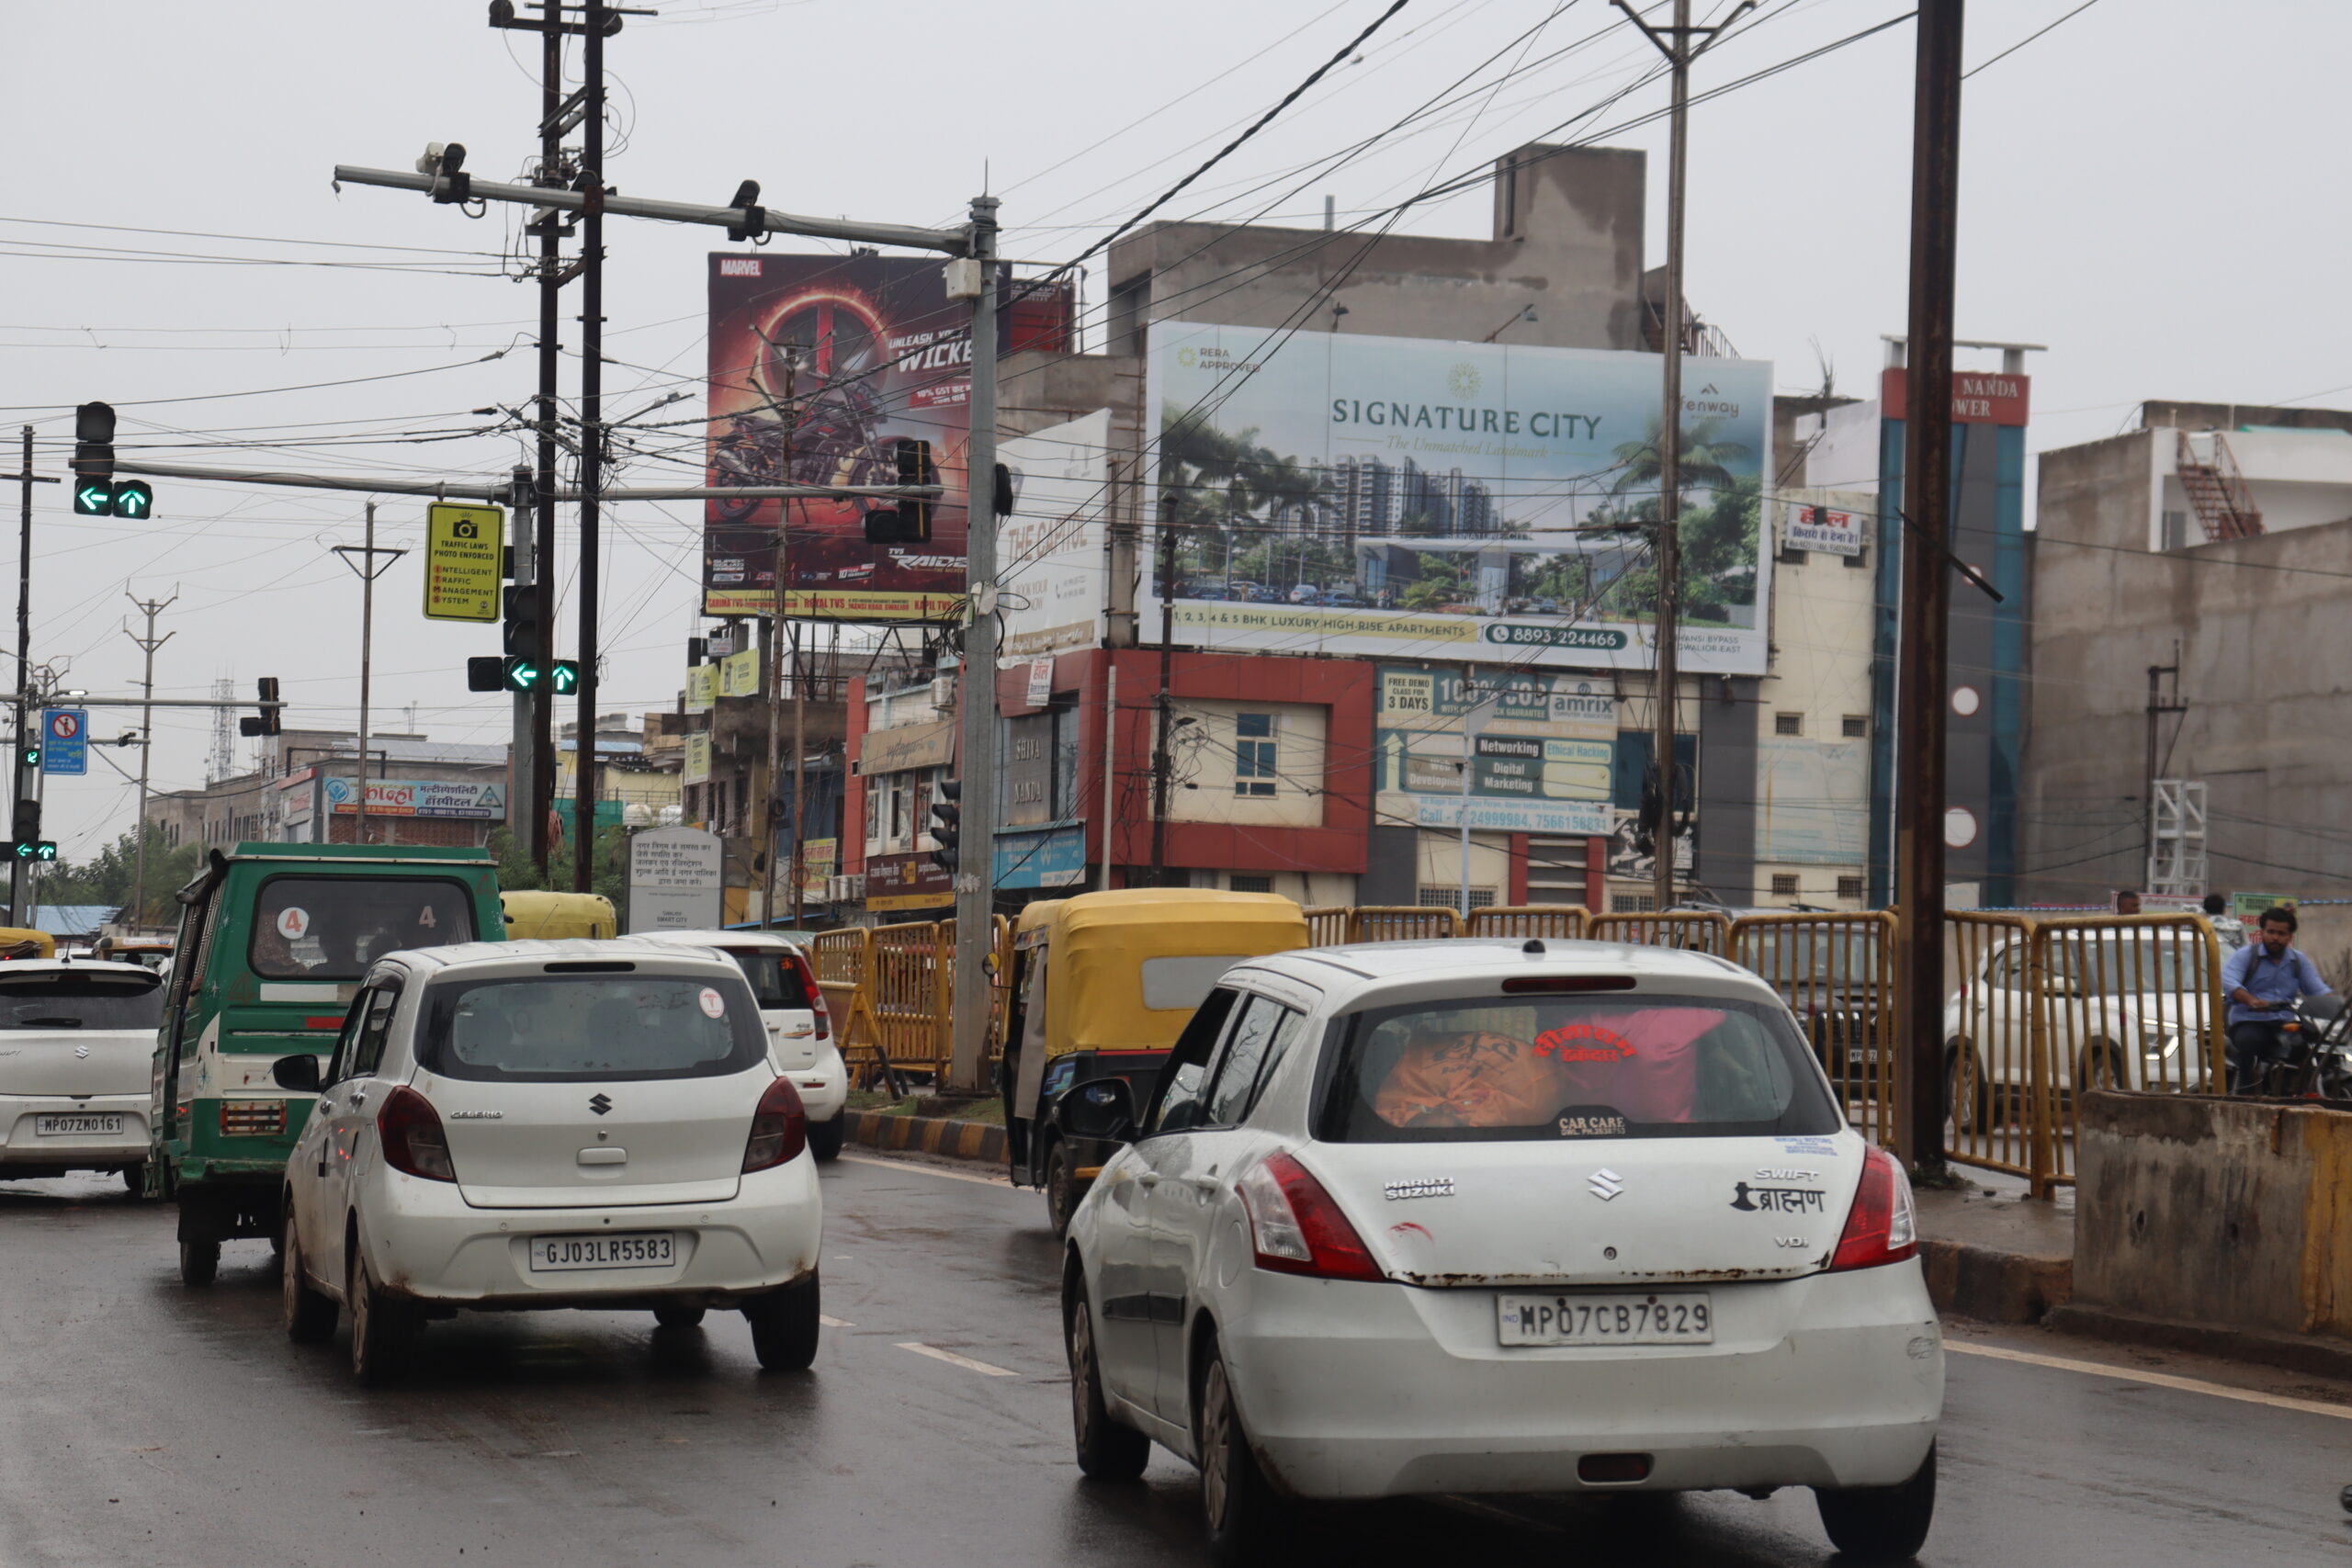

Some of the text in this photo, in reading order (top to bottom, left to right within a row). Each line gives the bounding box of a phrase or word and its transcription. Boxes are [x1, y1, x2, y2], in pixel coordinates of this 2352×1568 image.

[721, 259, 761, 276] MARVEL
[889, 333, 933, 349] UNLEASH
[899, 340, 972, 373] WICKE
[1200, 347, 1230, 358] RERA
[1199, 360, 1261, 373] APPROVED
[935, 387, 950, 395] GST
[1963, 378, 2018, 398] NANDA
[1679, 395, 1739, 419] fenway
[1333, 398, 1602, 441] SIGNATURE CITY
[1386, 434, 1549, 458] The Unmatched Landmark
[441, 540, 489, 550] TRAFFIC LAWS
[1009, 511, 1088, 565] THE CAPITOL
[459, 552, 494, 560] ENFORCED
[888, 555, 967, 570] RAIDE
[434, 565, 492, 576] INTELLIGENT
[433, 575, 471, 585] TRAFFIC
[433, 585, 493, 596] MANAGEMENT
[433, 595, 469, 604] SYSTEM
[804, 598, 828, 608] ROYAL
[830, 598, 845, 608] TVS
[1185, 612, 1193, 623] 2,
[1198, 613, 1205, 623] 3,
[1209, 614, 1216, 622] 4
[1221, 614, 1228, 623] &
[1233, 615, 1238, 623] 5
[1243, 615, 1267, 626] BHK
[1272, 616, 1319, 628] LUXURY
[1324, 619, 1383, 632] HIGH-RISE
[1387, 625, 1464, 637] APARTMENTS
[1514, 625, 1616, 647] 8893-224466
[1678, 634, 1738, 644] HANSI BYPASS
[1388, 678, 1430, 688] FREE DEMO
[1392, 687, 1411, 695] CLASS
[1506, 682, 1547, 706] JOB
[1388, 696, 1429, 710] 3 DAYS
[1554, 696, 1613, 713] amrix
[1016, 739, 1041, 761] SHIVA
[1480, 739, 1539, 758] Networking
[1547, 743, 1610, 761] Ethical Hacking
[1493, 762, 1525, 775] Digital
[1485, 777, 1533, 794] Marketing
[1014, 783, 1042, 805] NANDA
[1419, 808, 1442, 823] Call
[285, 910, 302, 932] 4
[418, 905, 436, 929] 4
[228, 972, 256, 1006] 4
[450, 1110, 503, 1119] CELERIO
[1559, 1116, 1625, 1129] CAR CARE
[45, 1118, 120, 1132] MP07ZM0161
[1755, 1168, 1820, 1182] SWIFT
[1385, 1177, 1454, 1190] MARUTI
[1385, 1185, 1455, 1201] SUZUKI
[1748, 1187, 1826, 1213] ब्राह्मण
[1774, 1236, 1809, 1248] VDi
[547, 1238, 670, 1264] GJ03LR5583
[1502, 1304, 1710, 1336] IND MP07CB7829
